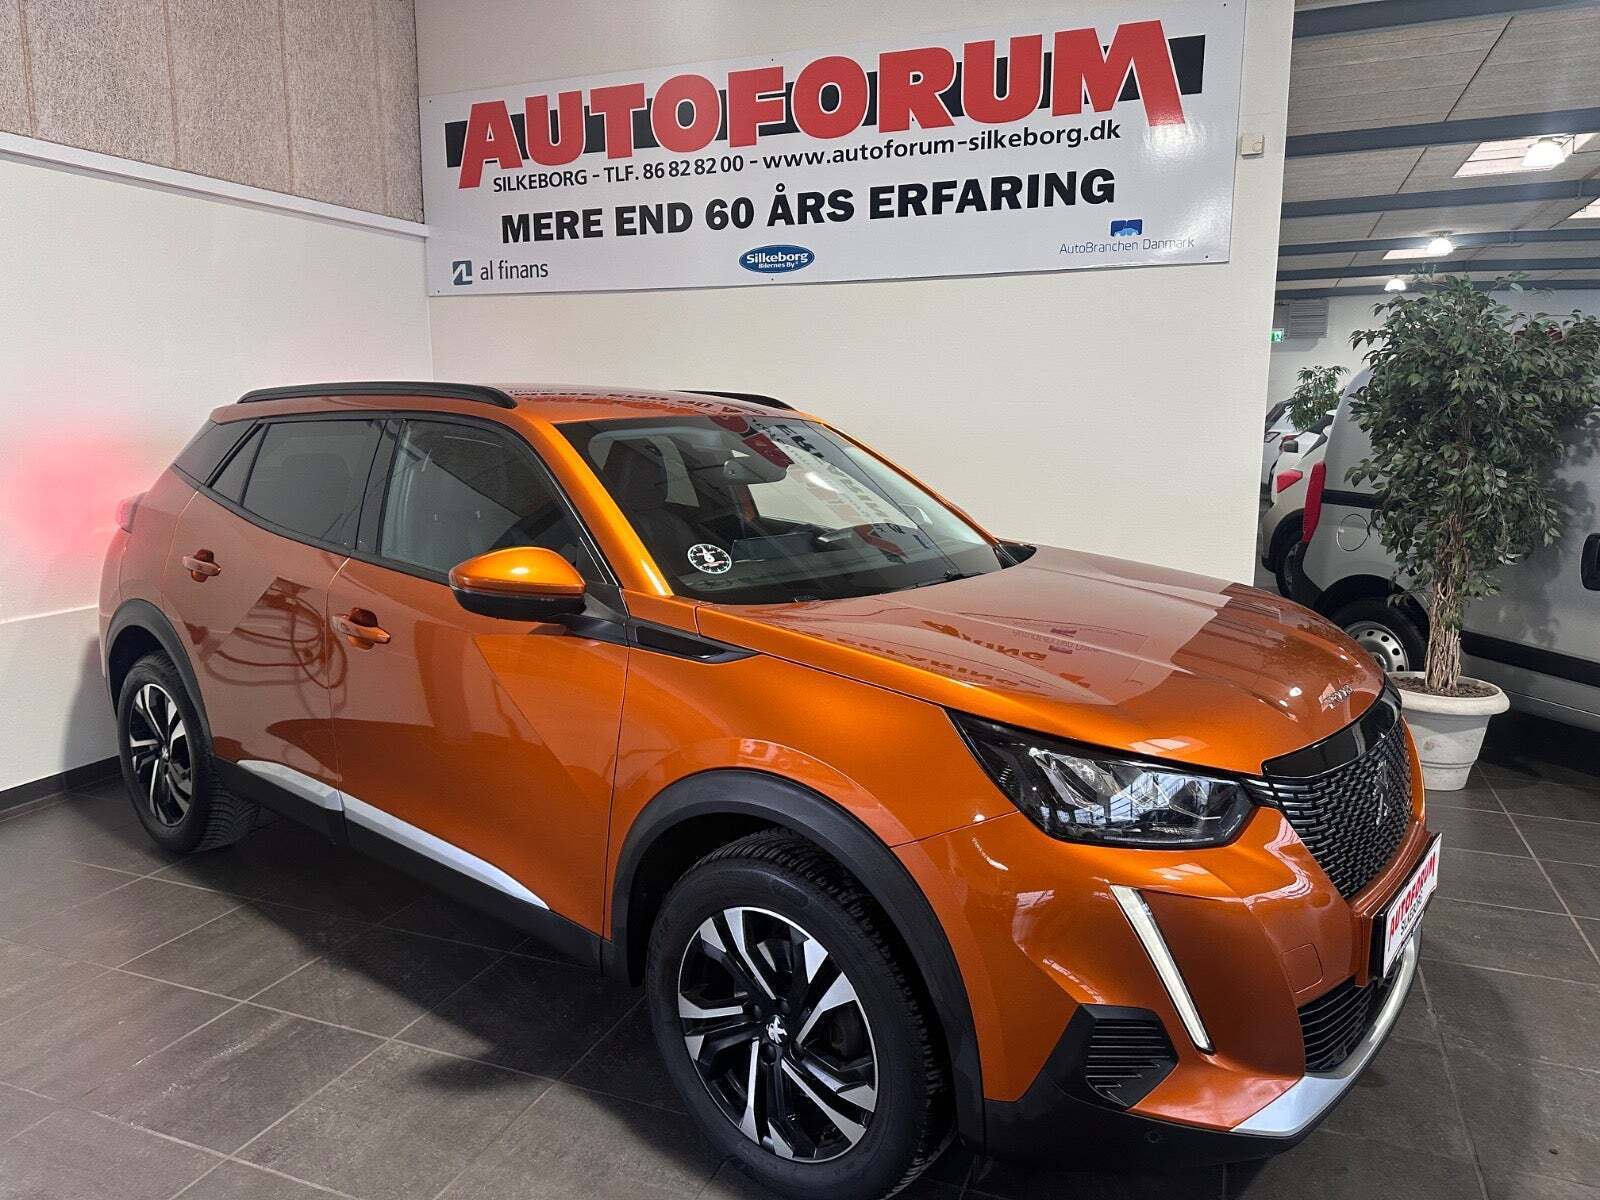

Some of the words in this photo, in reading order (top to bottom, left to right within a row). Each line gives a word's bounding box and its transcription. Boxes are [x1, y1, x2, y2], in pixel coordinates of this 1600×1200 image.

[458, 19, 1186, 190] AUTOFORUM
[493, 168, 588, 193] SILKEBORG
[603, 164, 640, 184] TLF.
[643, 161, 665, 180] 86
[668, 160, 691, 178] 82
[694, 157, 717, 176] 82
[720, 155, 744, 173] 00
[763, 119, 1121, 169] www.autoforum-silkeborg.dk
[501, 207, 604, 244] MERE
[615, 201, 694, 237] END
[705, 196, 754, 231] 60
[767, 182, 855, 227] ÅRS
[869, 168, 1115, 220] ERFARING
[746, 251, 809, 264] Silkeborg
[1059, 239, 1139, 254] AutoBranchen
[1142, 237, 1195, 251] Danmark
[480, 260, 494, 281] al
[498, 260, 549, 280] finans
